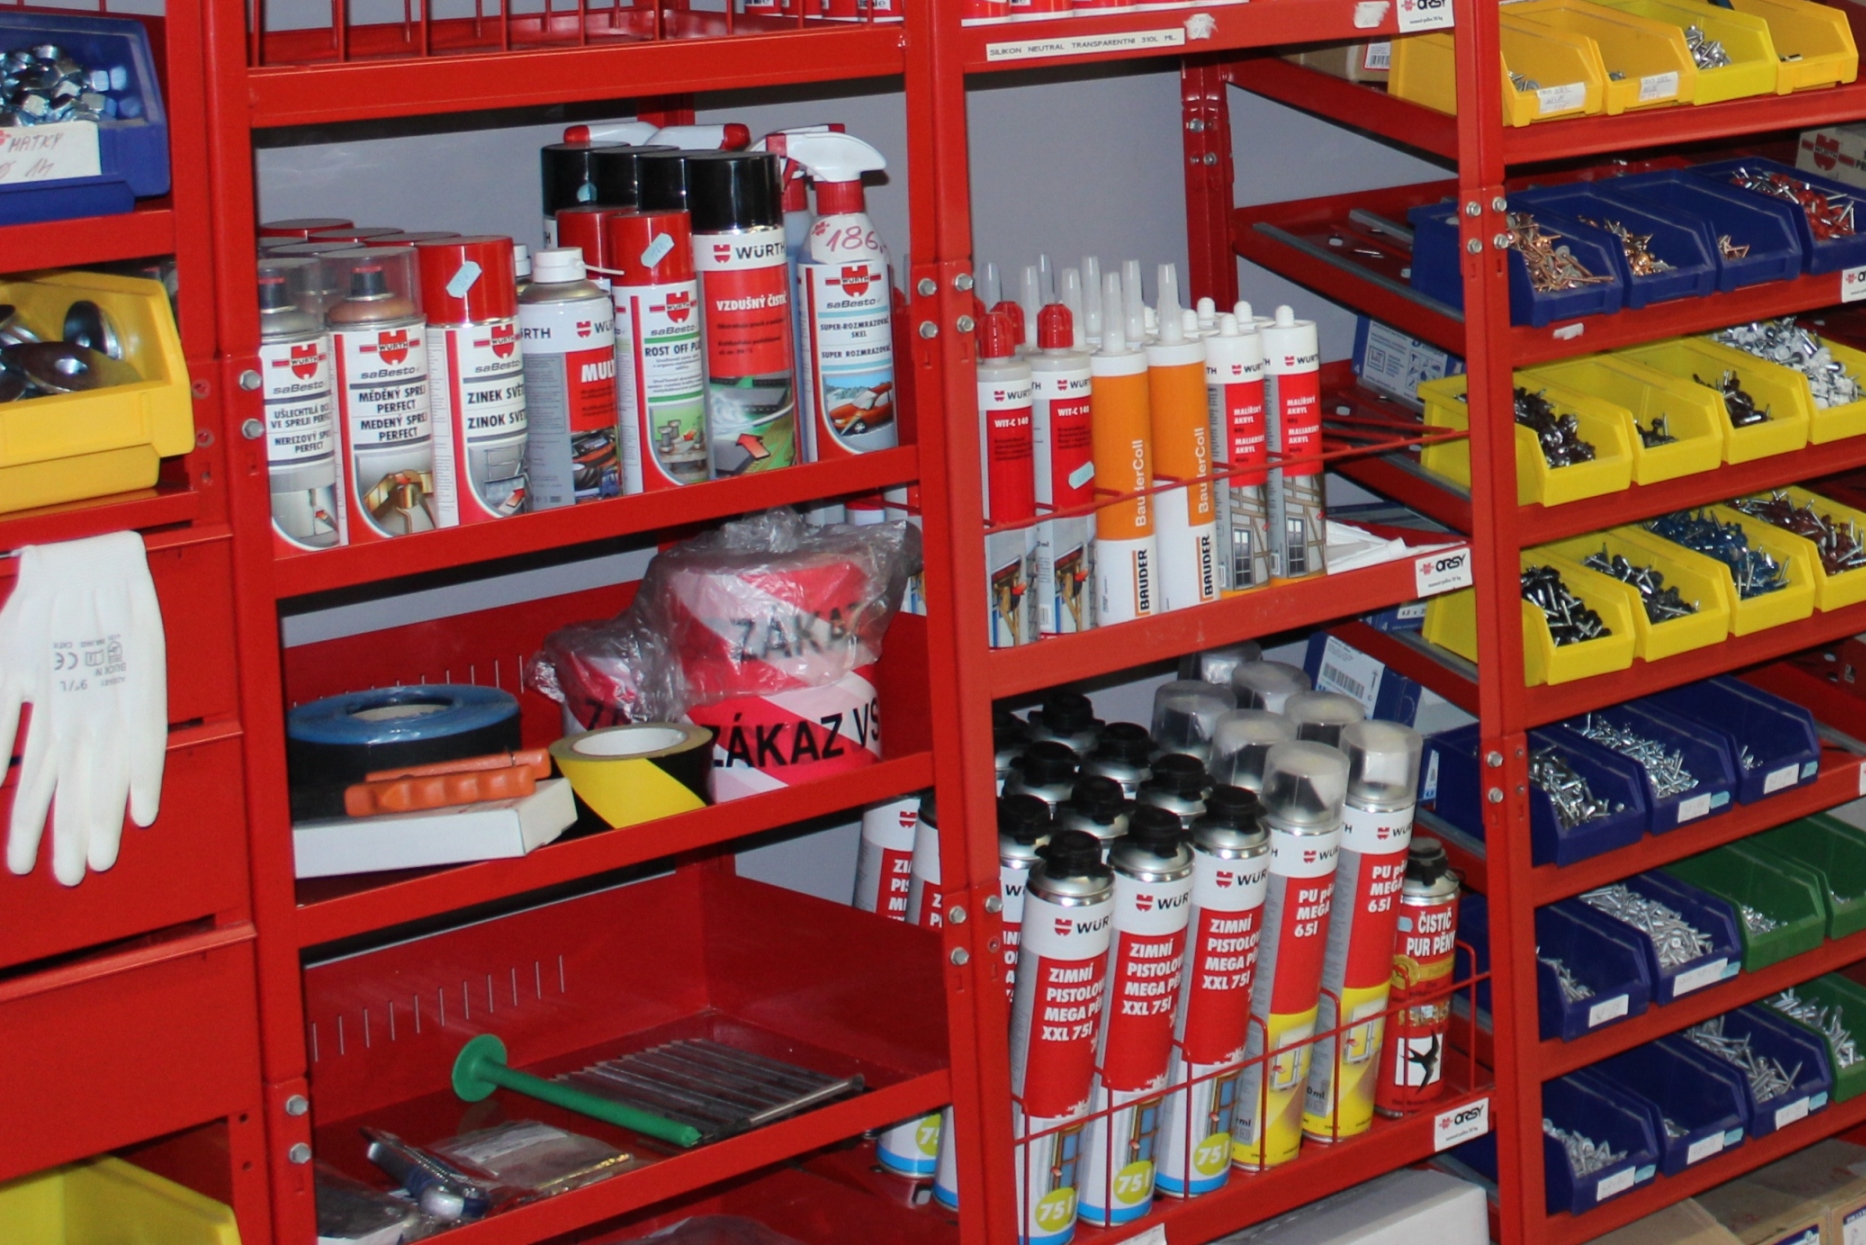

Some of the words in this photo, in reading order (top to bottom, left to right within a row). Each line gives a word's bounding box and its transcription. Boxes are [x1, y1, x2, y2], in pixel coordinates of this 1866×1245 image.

[990, 47, 1022, 56] SILIKON
[1028, 43, 1065, 52] NEUTRAL
[716, 296, 765, 312] VZDUŠNÝ
[826, 298, 876, 309] saBesto
[651, 324, 695, 336] saBesto
[645, 346, 669, 356] ROST
[674, 344, 689, 355] OFF
[821, 351, 843, 359] SUPER
[360, 366, 415, 380] saBesto
[475, 360, 520, 373] saBesto
[273, 380, 324, 395] saBesto
[468, 389, 503, 404] ZINEK
[377, 399, 416, 414] PERFECT
[1058, 407, 1078, 417] WIT-C
[1287, 407, 1307, 415] AKRYL
[271, 420, 282, 429] VE
[468, 414, 505, 429] ZINOK
[994, 419, 1016, 428] WIT-C
[1234, 416, 1254, 424] AKRYL
[379, 427, 418, 441] PERFECT
[1289, 436, 1308, 444] AKRYL
[295, 441, 324, 453] PERFECT
[1203, 534, 1216, 597] BAUDER
[1435, 554, 1466, 574] ORSY
[1137, 548, 1150, 613] BAUDER
[710, 711, 844, 770] ZÁKAZ
[1372, 865, 1392, 879] PU
[1369, 880, 1403, 897] MEGA
[1299, 889, 1320, 904] PU
[1297, 902, 1330, 920] MEGA
[1210, 914, 1252, 933] ZIMNÍ
[1418, 907, 1452, 934] ČISTIČ
[1130, 938, 1173, 958] ZIMNÍ
[1406, 937, 1430, 957] PUR
[1204, 956, 1244, 971] MEGA
[1049, 963, 1094, 983] ZIMNÍ
[1124, 981, 1166, 996] MEGA
[1202, 975, 1229, 991] XXL
[1044, 1006, 1087, 1022] MEGA
[1122, 1000, 1150, 1016] XXL
[1041, 1025, 1070, 1041] XXL
[1453, 1105, 1485, 1128] ORSY
